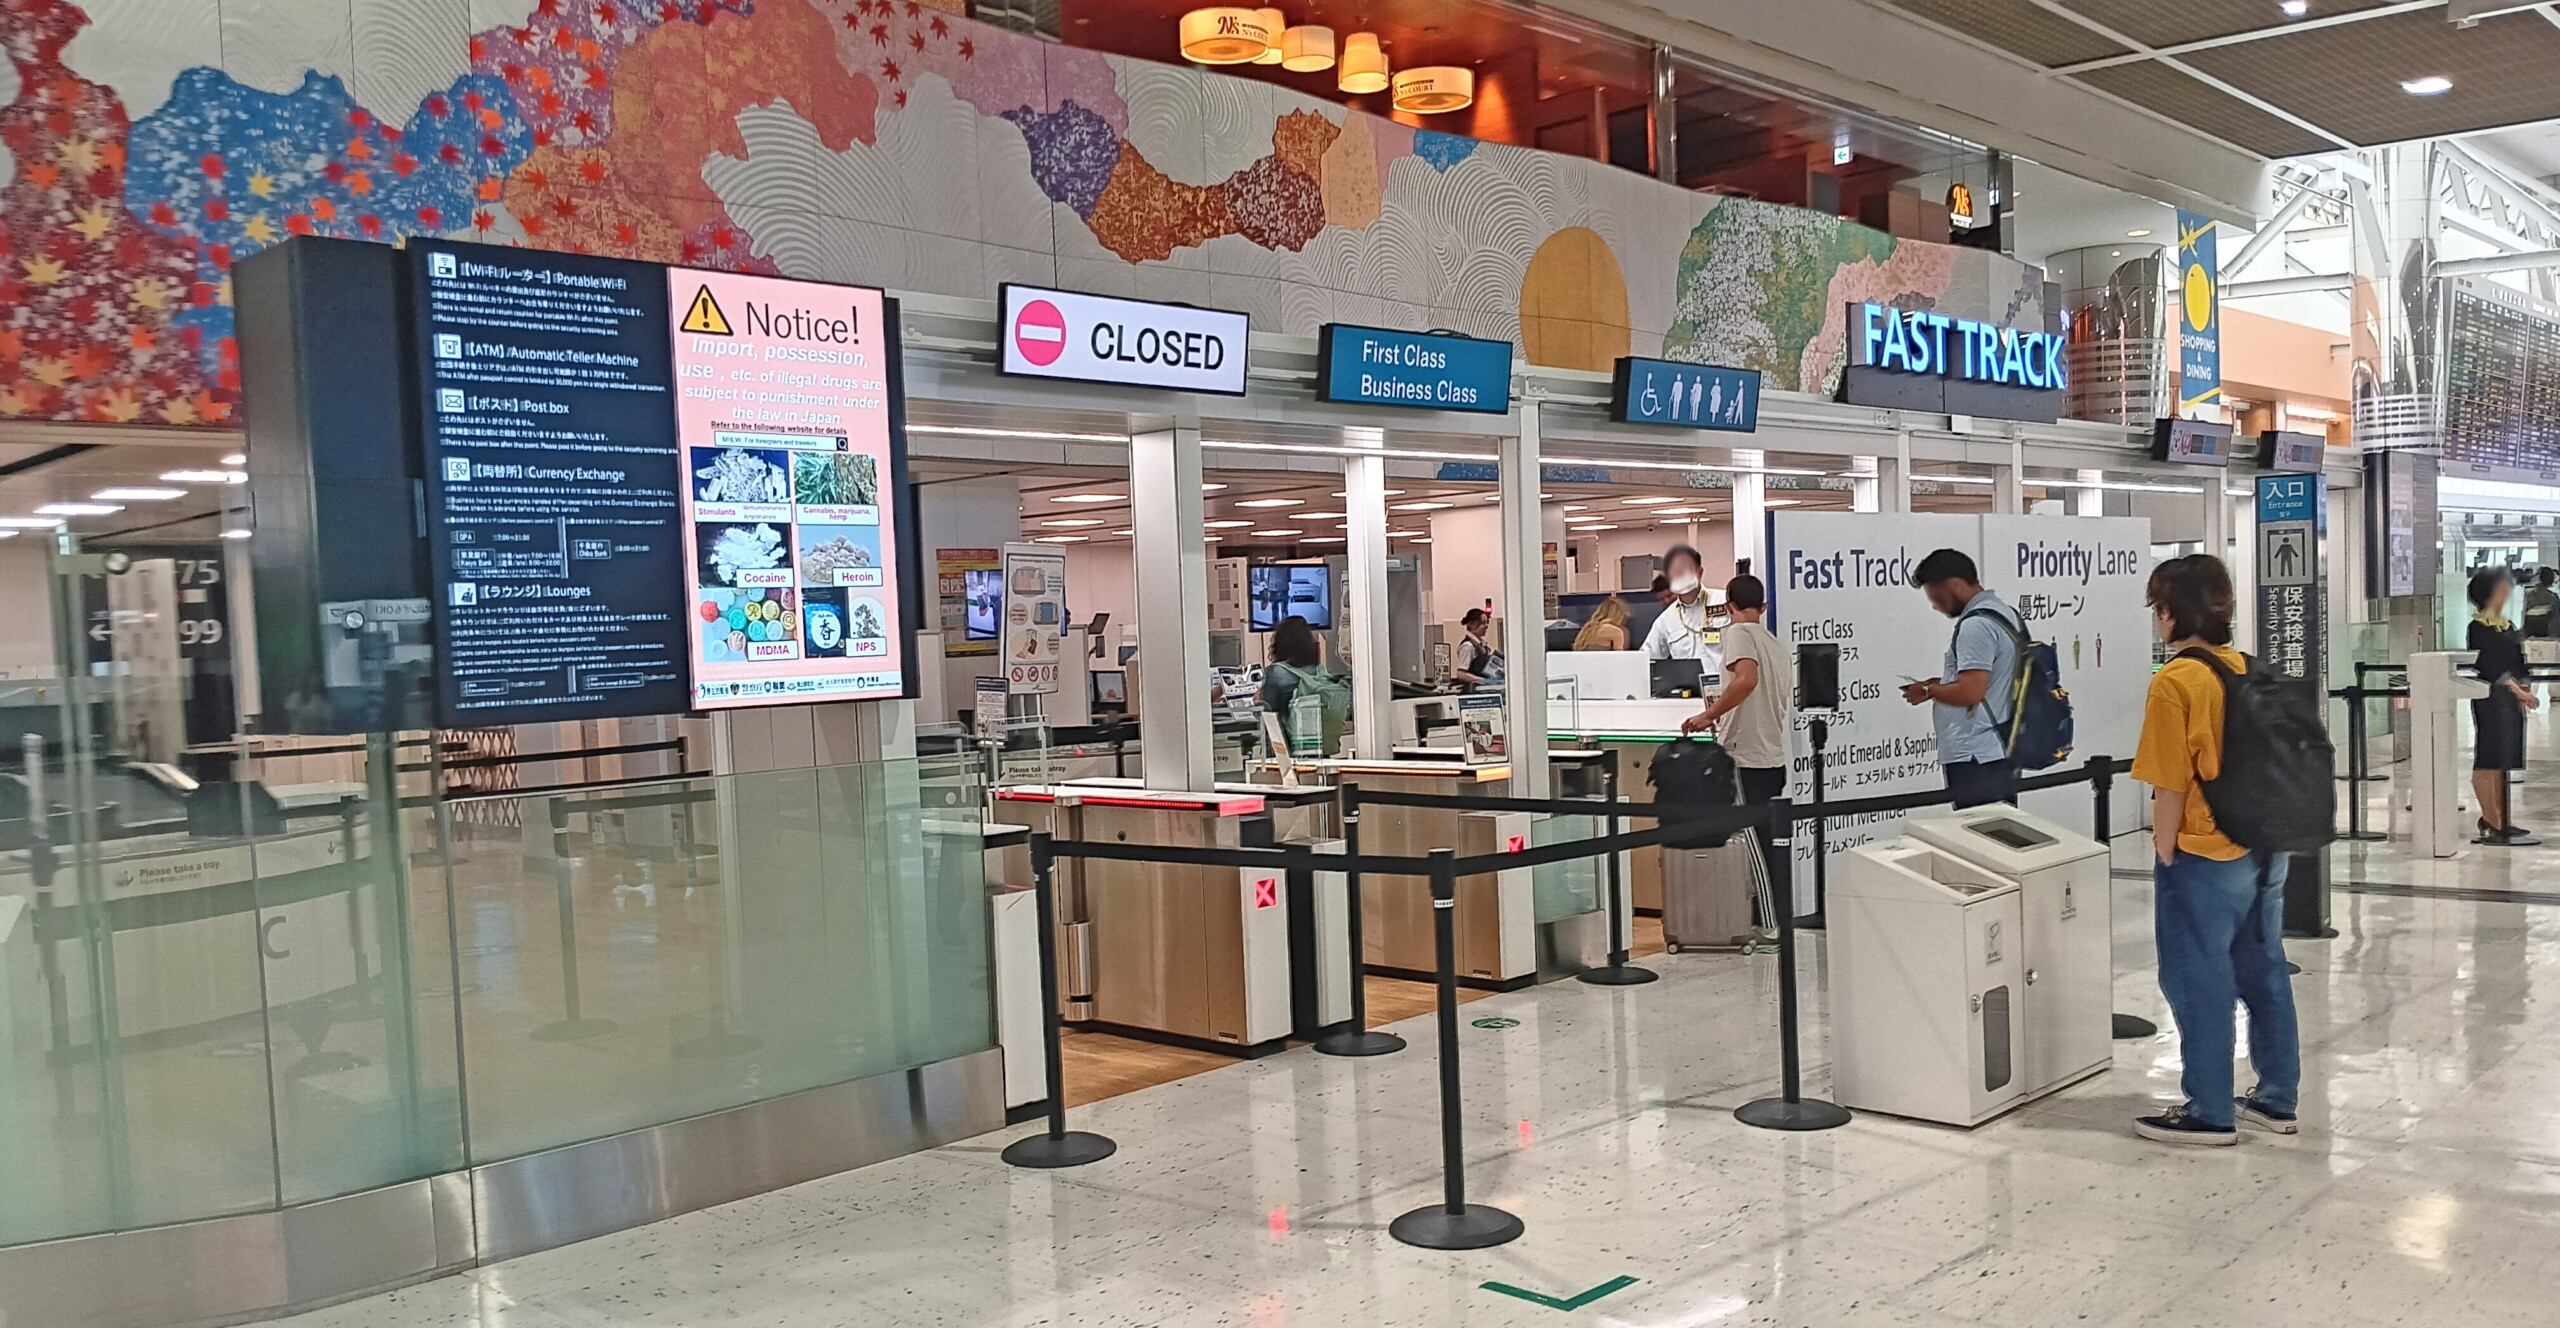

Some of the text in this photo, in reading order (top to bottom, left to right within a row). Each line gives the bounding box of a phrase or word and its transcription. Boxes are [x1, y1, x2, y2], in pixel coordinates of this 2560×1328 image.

[557, 271, 599, 289] Portable
[600, 276, 627, 291] Wi-Fi
[746, 301, 859, 345] Notice!
[692, 337, 868, 368] Import, possession,
[1091, 322, 1224, 370] CLOSED
[1363, 339, 1446, 369] First Class
[1863, 302, 2066, 390] FAST TRACK
[2180, 334, 2216, 353] SHOPPING
[511, 346, 564, 362] Automatic
[566, 349, 594, 364] Teller
[596, 352, 639, 368] Machine
[681, 364, 882, 391] use etc. of illegal drugs are
[2186, 366, 2212, 380] DINING
[685, 386, 880, 409] subject to punishment under
[1360, 374, 1477, 404] Business Class
[525, 400, 548, 412] Post
[549, 402, 569, 414] box
[732, 406, 840, 426] the law in Japan
[711, 421, 847, 436] Refer to the following website for details
[445, 439, 460, 447] There
[528, 465, 574, 481] Currency
[577, 468, 625, 483] Exchange
[2266, 481, 2304, 500] 入口
[698, 508, 736, 516] Stimulants
[803, 506, 871, 516] Cannabis, marijuana,
[2268, 501, 2303, 509] Entrance
[829, 513, 847, 521] hemp
[177, 560, 220, 584] 75
[1789, 546, 1913, 590] Fast Track
[2017, 540, 2138, 586] Priority Lane
[744, 573, 787, 583] Cocaine
[841, 572, 874, 582] Heroin
[549, 585, 591, 599] Lounges
[2018, 594, 2086, 621] 優先レーン
[179, 619, 223, 644] 99
[1791, 618, 1854, 642] First Class
[2268, 587, 2280, 664] Security Check
[2283, 586, 2304, 678] 保安検査場
[756, 646, 790, 656] MDMA
[856, 641, 877, 652] NPS
[1850, 679, 1880, 701] Class
[1217, 755, 1230, 763] tray.
[1793, 744, 1847, 773] oneorld
[1850, 737, 1891, 765] Emerald
[1894, 738, 1902, 757] &
[1794, 774, 1847, 797] ワンールド
[1855, 766, 1895, 786] エメラルド
[1898, 765, 1905, 778] &
[1797, 834, 1874, 861] プレアムメンバー
[139, 867, 172, 877] Please
[173, 863, 195, 874] take
[203, 861, 221, 870] tray.
[261, 914, 291, 960] C
